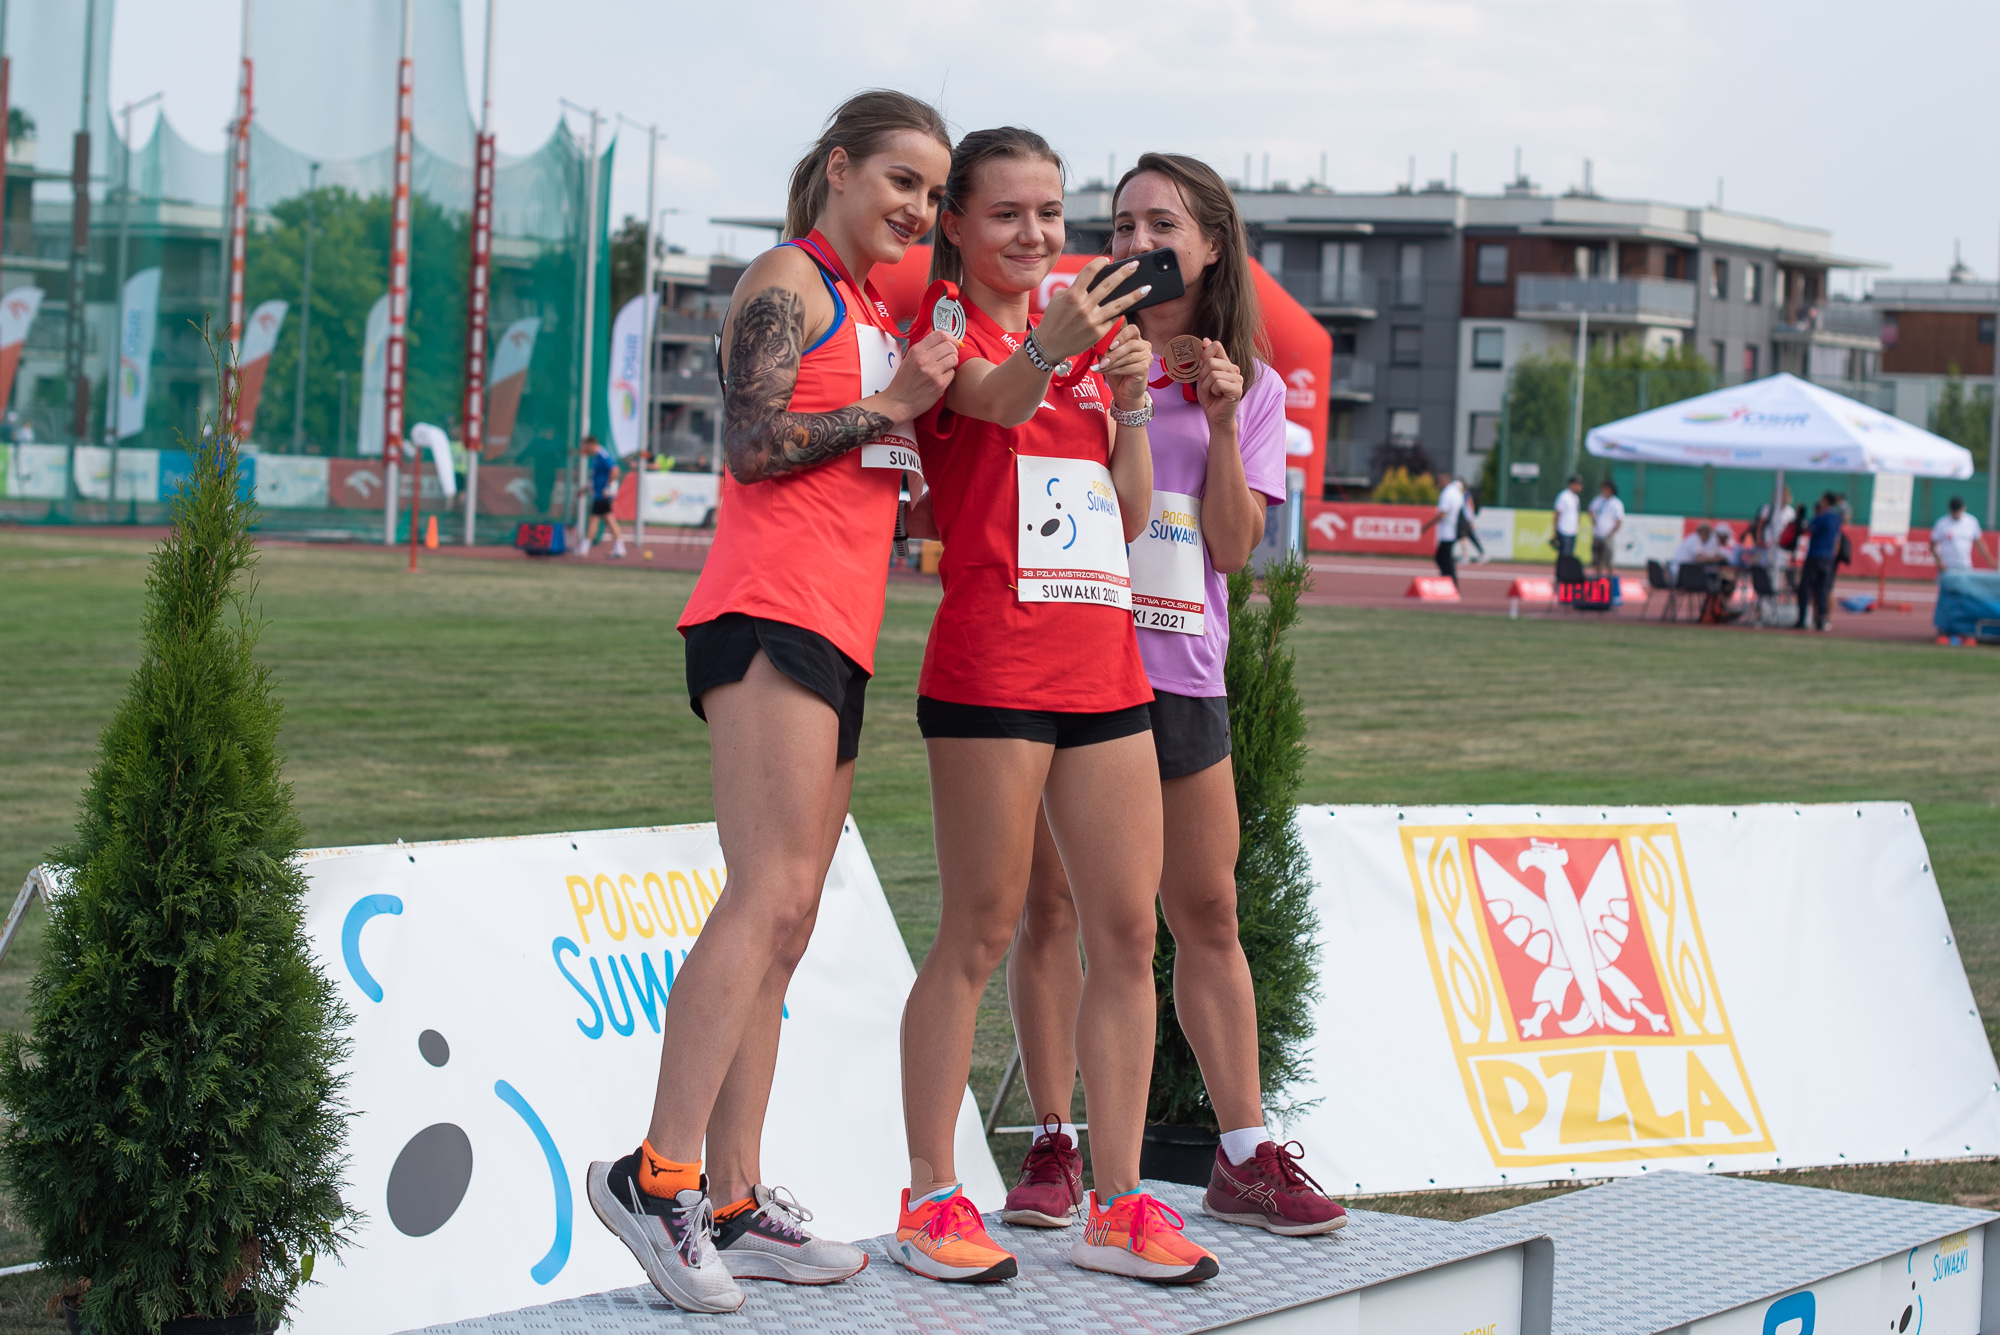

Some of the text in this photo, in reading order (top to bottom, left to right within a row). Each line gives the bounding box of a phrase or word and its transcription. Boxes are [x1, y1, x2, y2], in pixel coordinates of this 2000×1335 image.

[874, 301, 889, 318] MCC
[1161, 510, 1197, 529] POGODNE
[1149, 519, 1198, 546] SUWAŁKI
[1036, 570, 1057, 578] PZLA
[1058, 570, 1106, 580] MISTRZOSTWA
[1042, 584, 1120, 604] SUWAŁKI 2021
[1160, 599, 1189, 609] POLSKI
[1189, 604, 1201, 612] U23
[1150, 612, 1185, 629] 2021
[565, 867, 728, 945] POGODN
[1474, 1050, 1754, 1149] PZLA
[1932, 1249, 1968, 1282] SUWAŁKI
